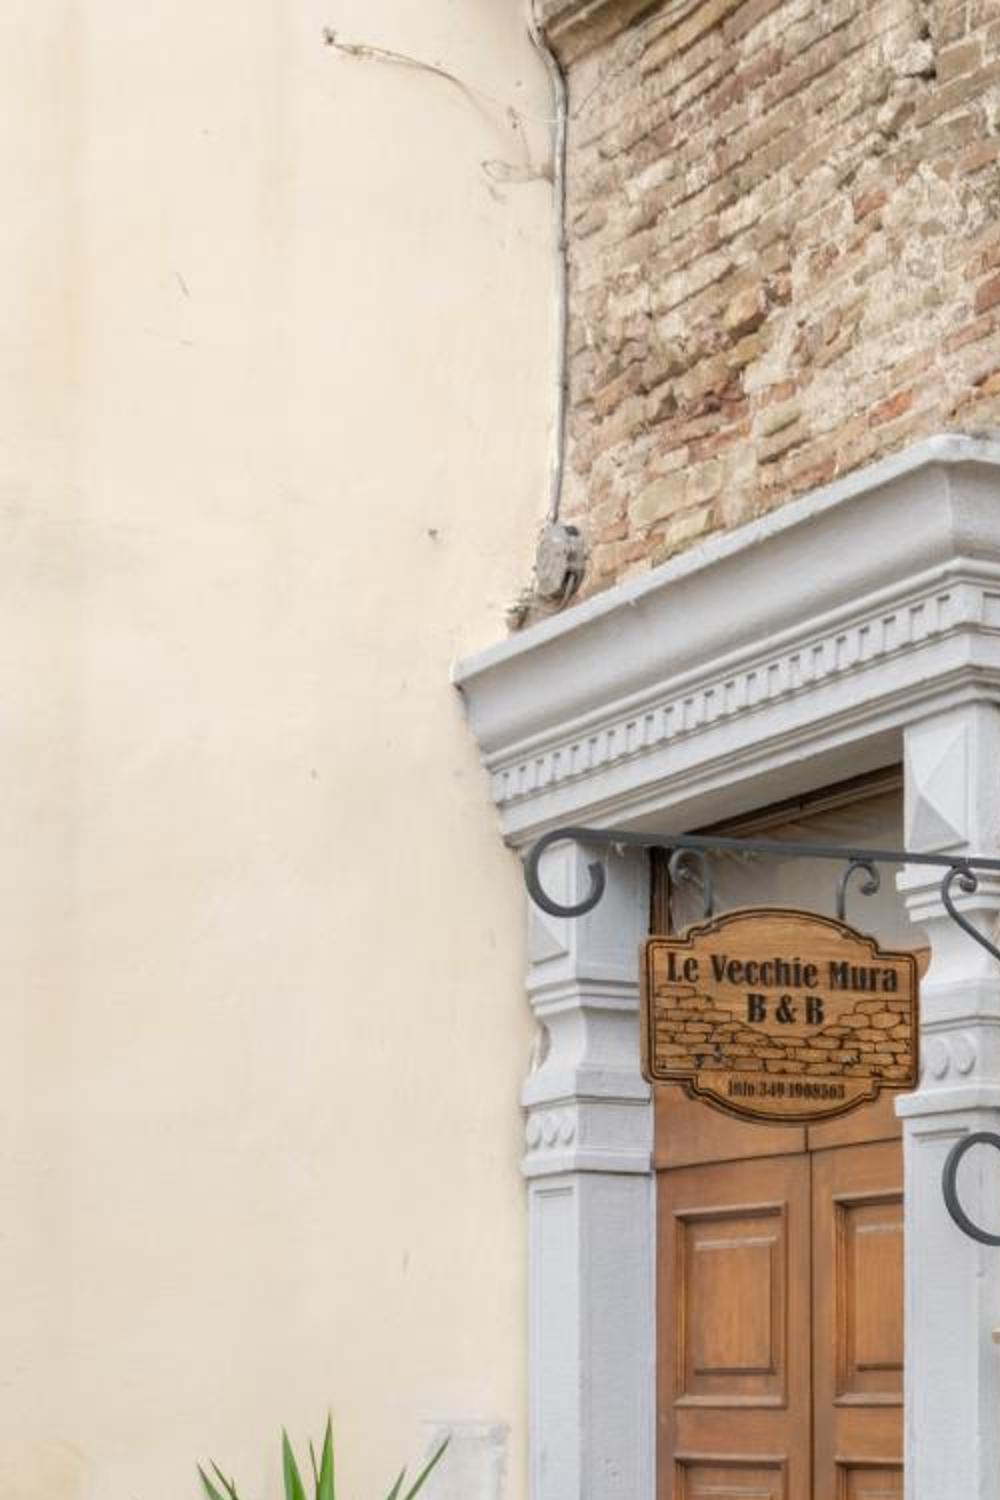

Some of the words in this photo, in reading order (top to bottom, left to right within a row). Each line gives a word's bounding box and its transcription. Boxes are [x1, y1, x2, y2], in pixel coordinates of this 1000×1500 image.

[667, 953, 699, 982] Le
[710, 954, 818, 988] Vecchie
[828, 961, 898, 992] Mura
[748, 993, 767, 1023] B
[776, 995, 796, 1025] &
[805, 996, 825, 1025] B
